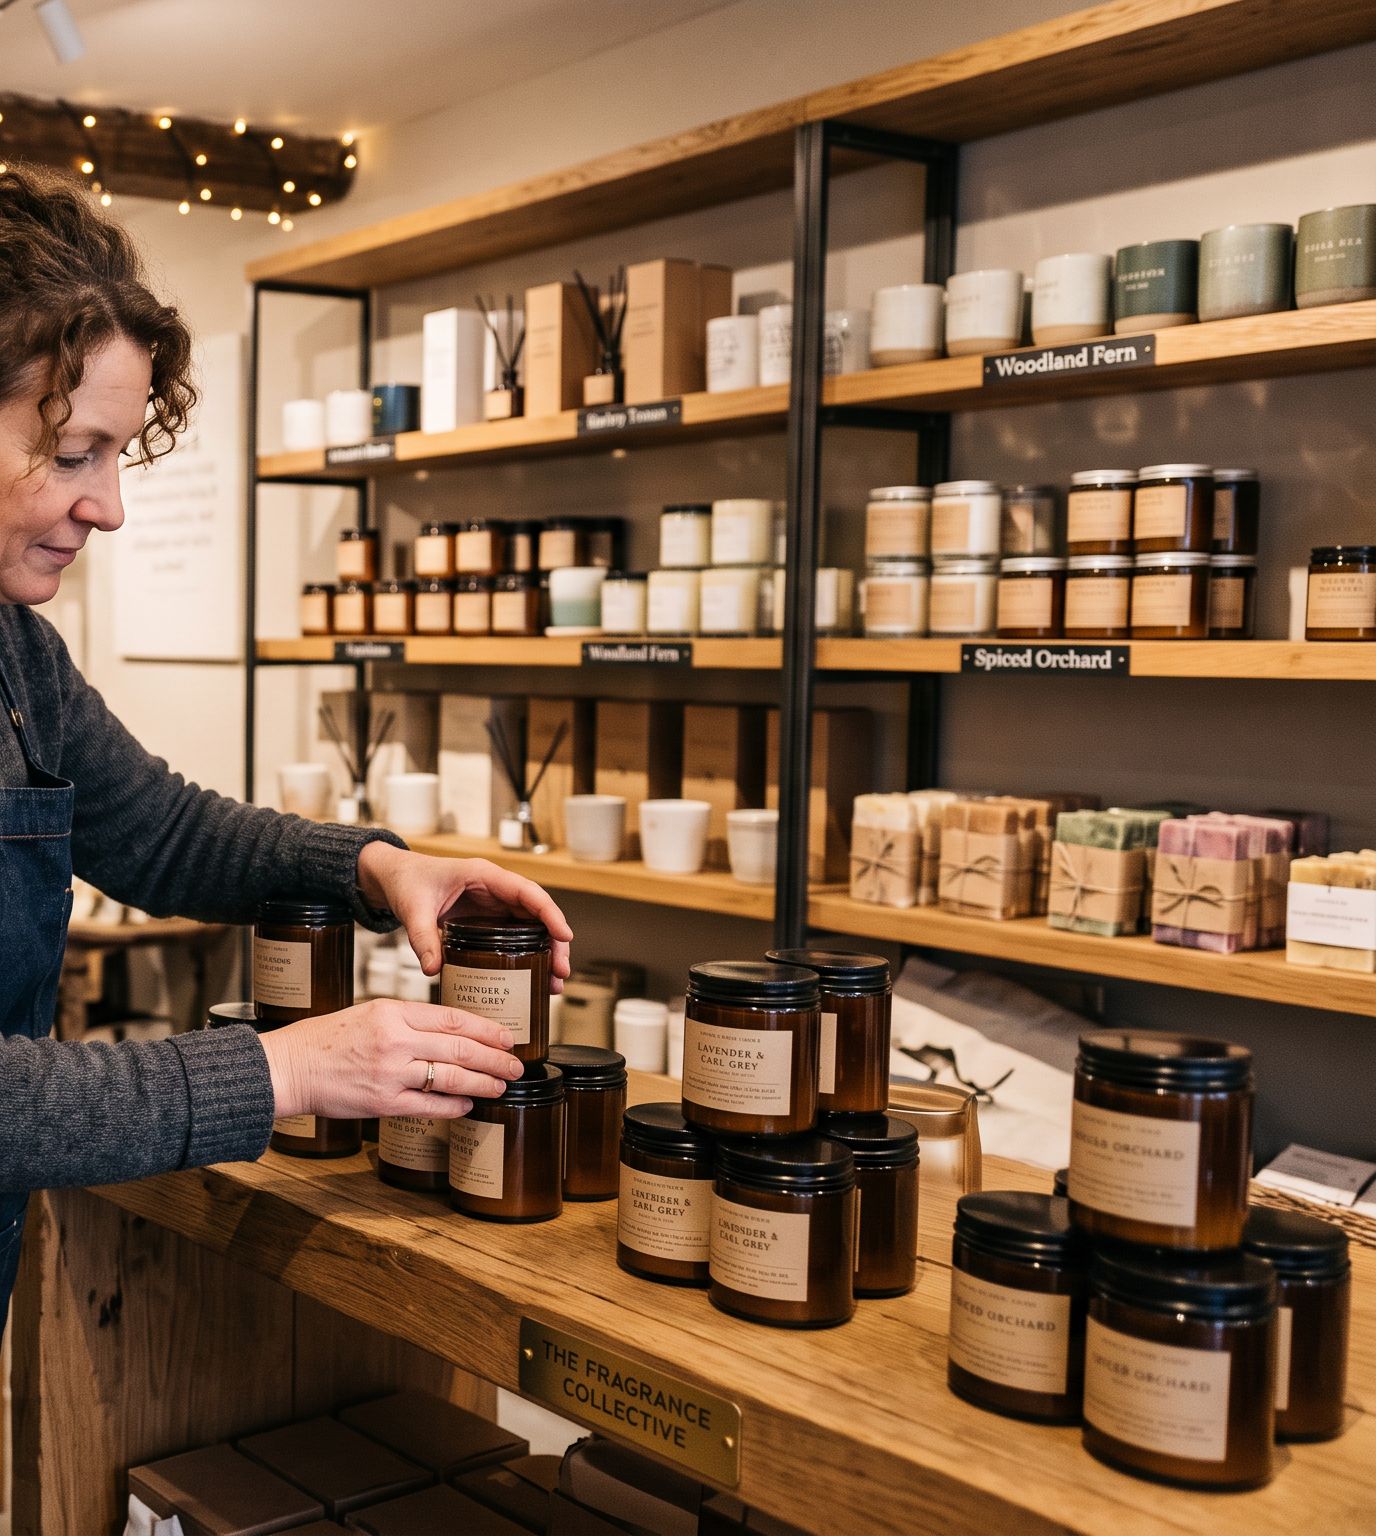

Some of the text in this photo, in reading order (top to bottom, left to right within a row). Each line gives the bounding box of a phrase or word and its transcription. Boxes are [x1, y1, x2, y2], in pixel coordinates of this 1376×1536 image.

[995, 345, 1138, 377] Woodland Fern
[589, 645, 648, 661] Woodland
[974, 648, 1112, 671] Spiced Orchard
[481, 997, 506, 1005] GREY
[697, 1042, 765, 1060] LAVENDER &
[728, 1061, 758, 1070] GREY
[1112, 1142, 1184, 1161] ORCHARD
[657, 1206, 685, 1217] GREY
[742, 1239, 771, 1251] GREY
[987, 1310, 1056, 1332] ORCHARD
[542, 1339, 711, 1431] THE FRAGRANCE
[563, 1378, 686, 1449] COLLECTIVE
